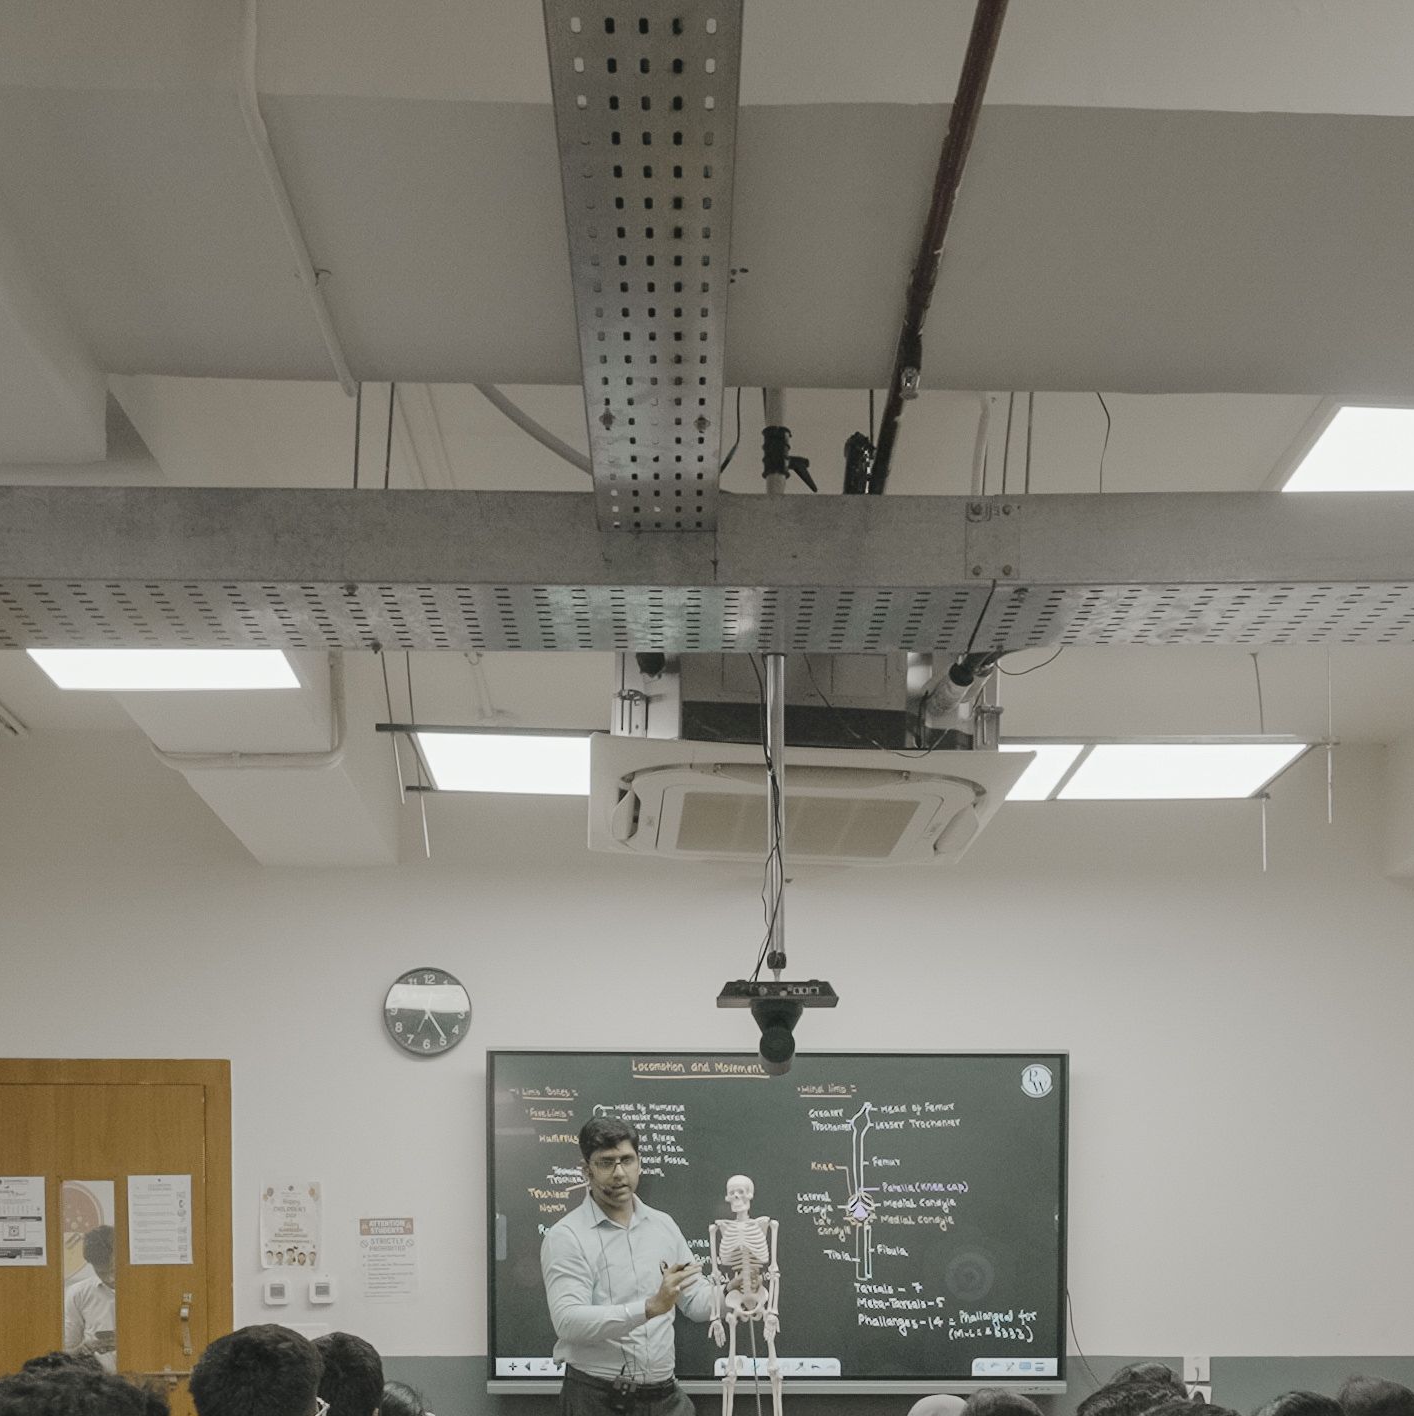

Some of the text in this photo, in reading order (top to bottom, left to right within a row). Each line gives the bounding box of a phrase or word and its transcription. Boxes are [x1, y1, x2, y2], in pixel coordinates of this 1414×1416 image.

[423, 975, 435, 984] 12
[395, 1022, 402, 1032] 8
[452, 1025, 458, 1034] 4
[407, 1034, 414, 1044] 7
[423, 1039, 430, 1049] 6
[632, 1060, 765, 1073] Locomotion and Movement
[872, 1156, 900, 1167] Femur
